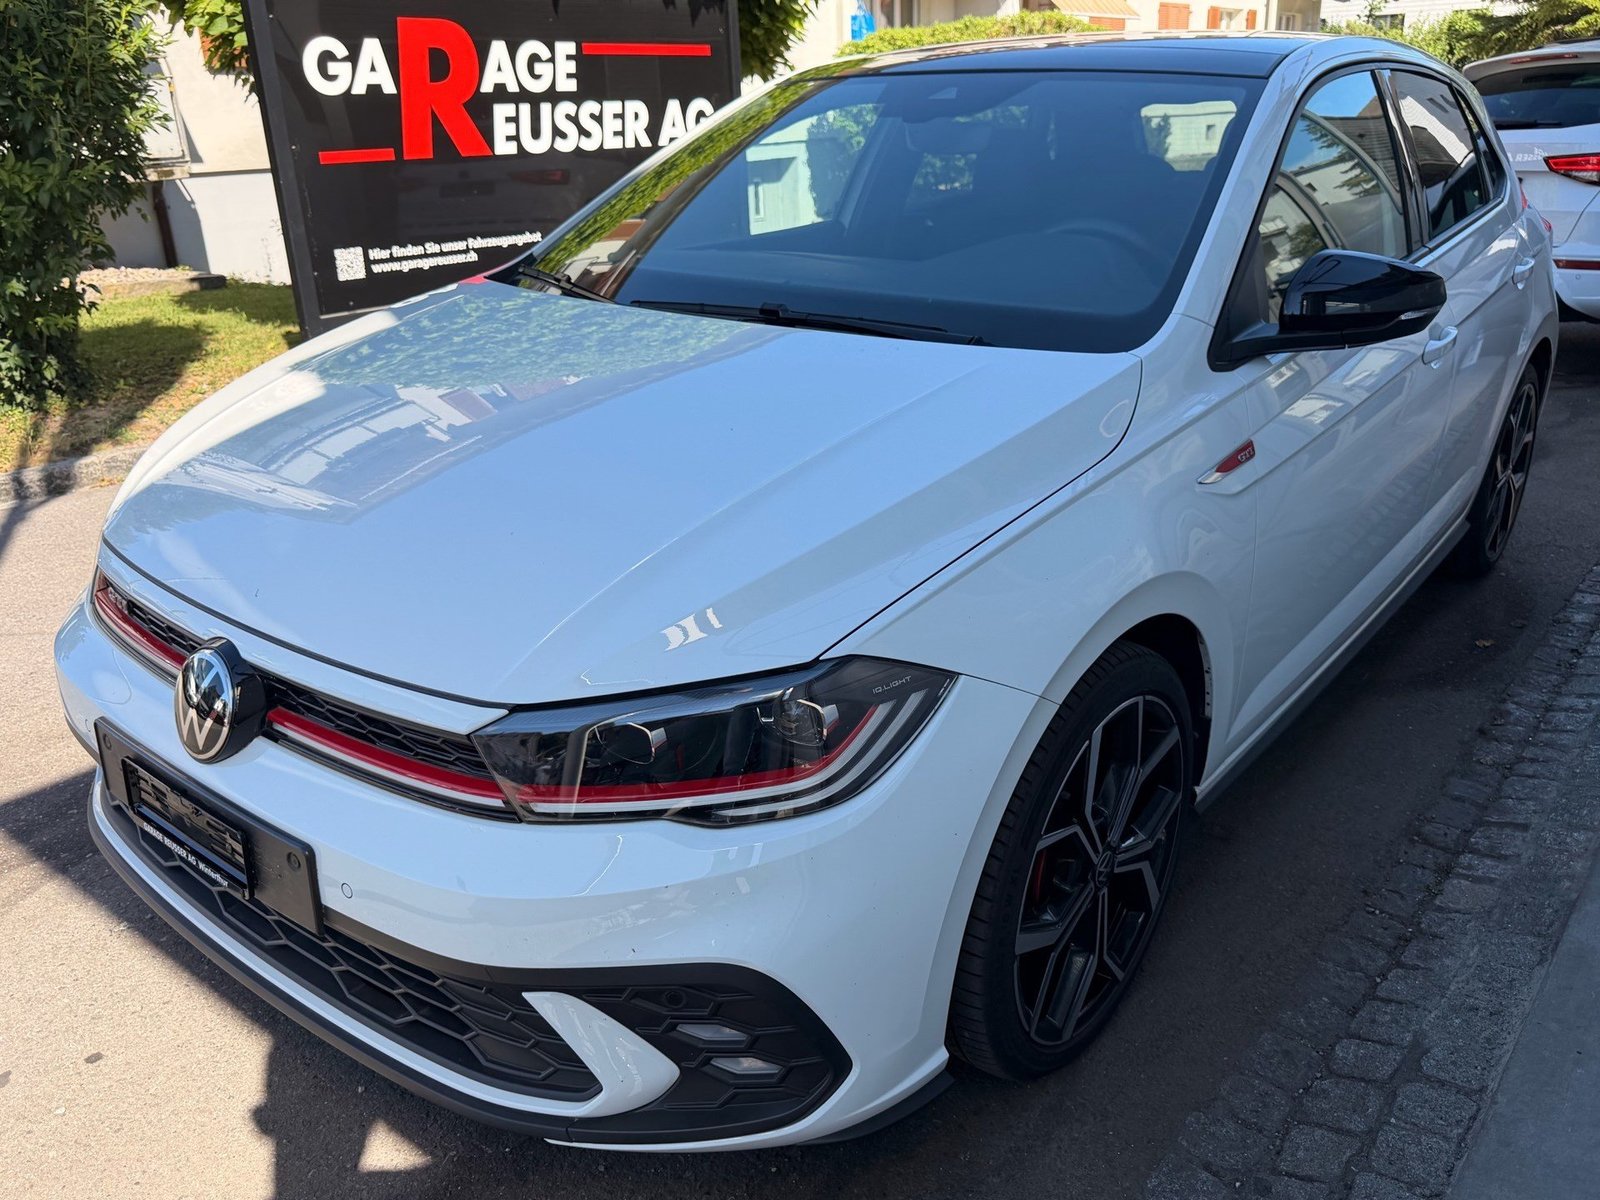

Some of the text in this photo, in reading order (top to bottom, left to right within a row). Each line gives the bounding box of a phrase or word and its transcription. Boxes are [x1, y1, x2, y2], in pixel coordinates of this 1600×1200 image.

[302, 17, 578, 160] GARAGE
[658, 97, 715, 147] AG
[368, 231, 542, 261] Hier finden Sie unser Fahrzeugangebot
[370, 250, 479, 273] www.garagereusser.ch
[143, 822, 163, 842] GARAGE
[163, 836, 187, 859] REUSSER
